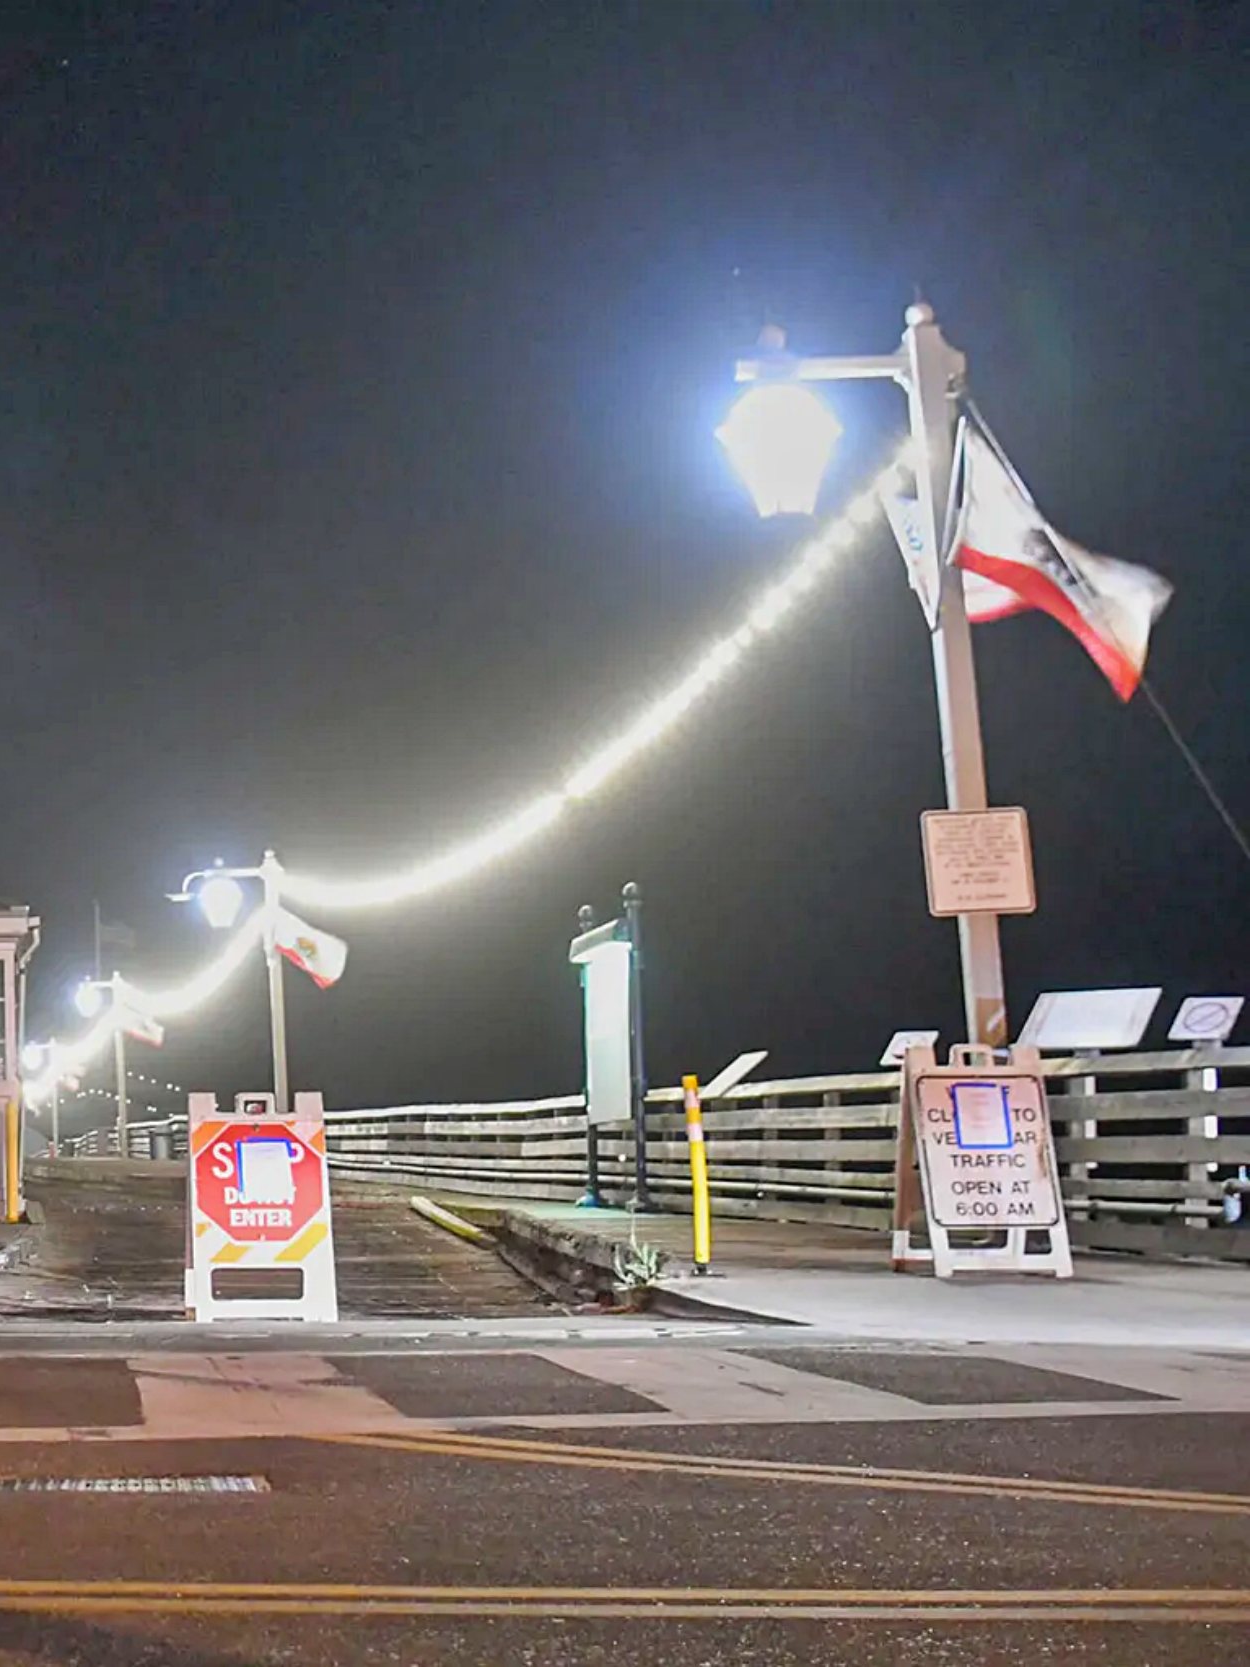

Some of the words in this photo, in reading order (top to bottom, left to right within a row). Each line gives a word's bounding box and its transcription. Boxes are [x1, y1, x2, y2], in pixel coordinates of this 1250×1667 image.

[1012, 1108, 1036, 1122] TO
[211, 1141, 306, 1180] SP
[950, 1153, 1027, 1168] TRAFFIC
[951, 1181, 1002, 1195] OPEN
[1011, 1180, 1031, 1194] AT
[956, 1202, 999, 1216] 6:00
[1006, 1202, 1035, 1216] AM
[230, 1208, 292, 1227] ENTER
